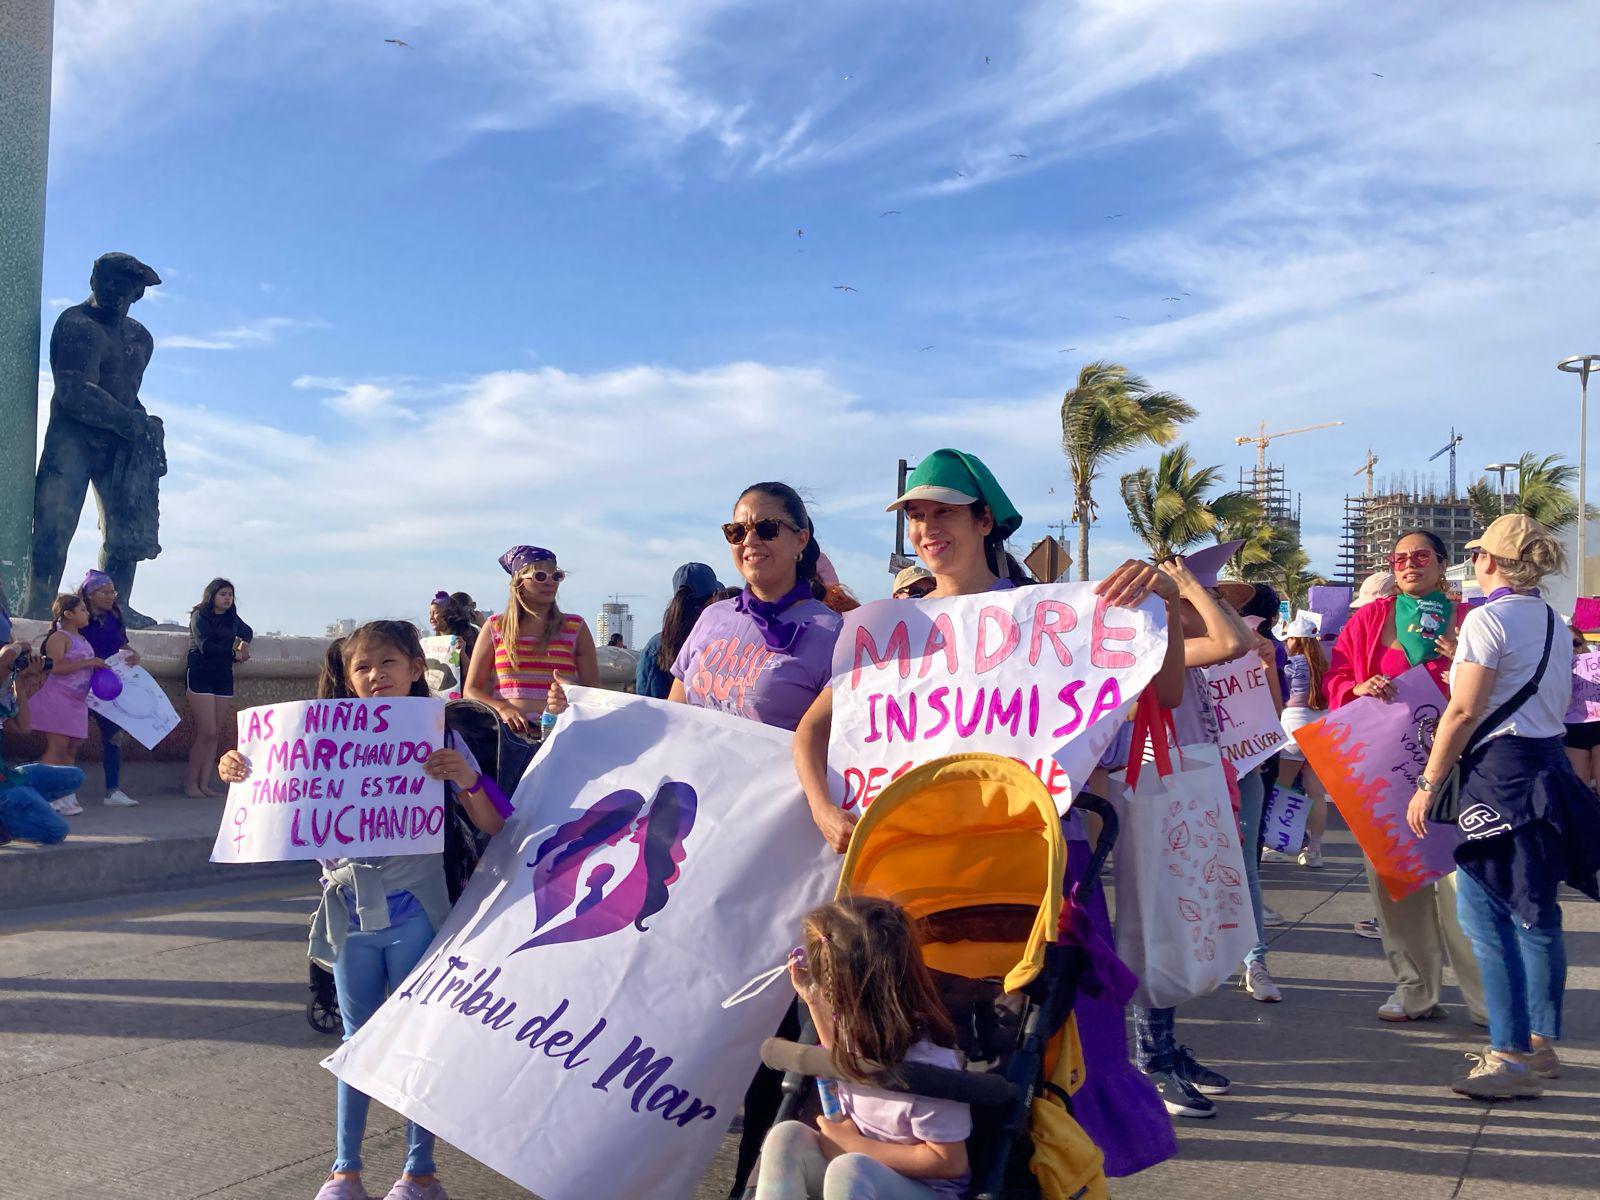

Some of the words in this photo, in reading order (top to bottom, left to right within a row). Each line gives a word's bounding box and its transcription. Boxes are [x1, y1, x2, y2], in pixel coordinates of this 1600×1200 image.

[851, 599, 1137, 690] MADRE
[1246, 666, 1265, 689] DE
[240, 709, 274, 744] LAS
[305, 701, 392, 734] NIÑAS
[864, 677, 1121, 744] INSUMISA
[267, 738, 433, 774] MARCHANDO
[251, 777, 345, 805] TAMBIEN
[361, 775, 426, 798] ESTAN
[290, 804, 444, 848] LUCHANDO
[515, 998, 607, 1070] del
[592, 1036, 717, 1128] Mar
